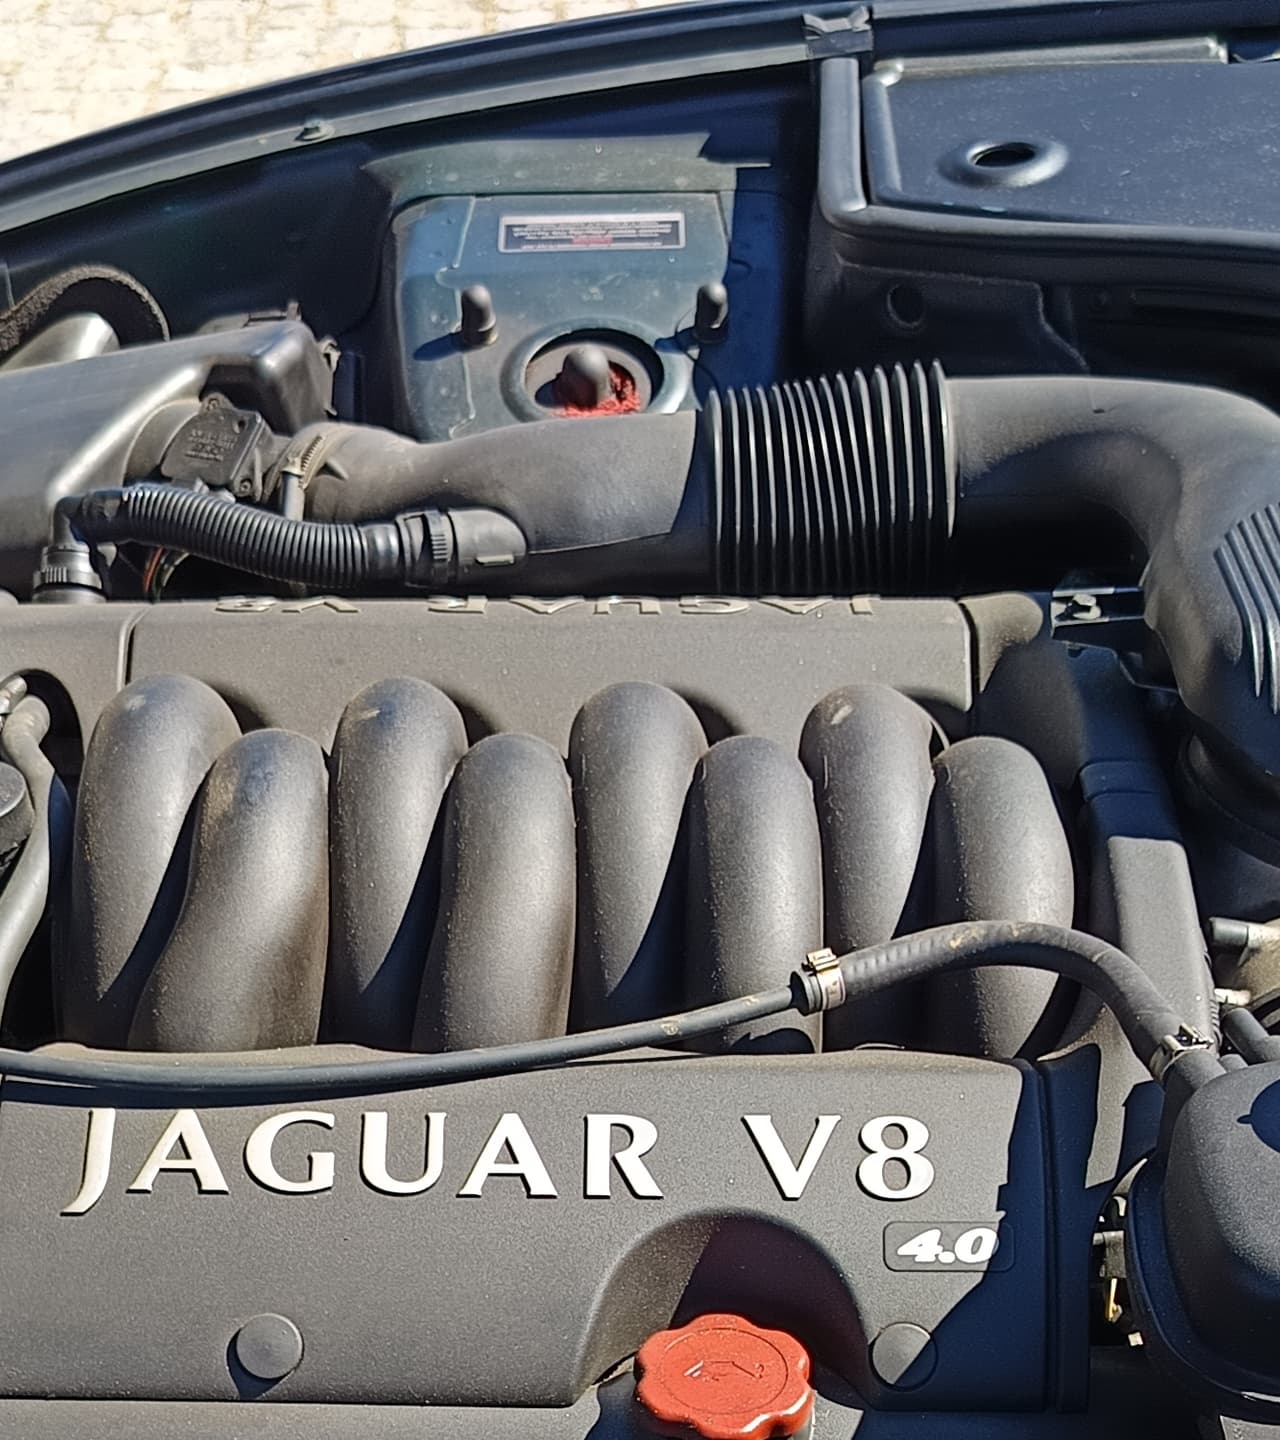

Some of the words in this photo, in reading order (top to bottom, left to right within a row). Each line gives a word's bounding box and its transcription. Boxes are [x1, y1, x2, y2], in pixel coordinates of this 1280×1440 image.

[58, 1106, 665, 1217] JAGUAR
[741, 1113, 936, 1202] V8
[897, 1226, 1000, 1264] 4.0
